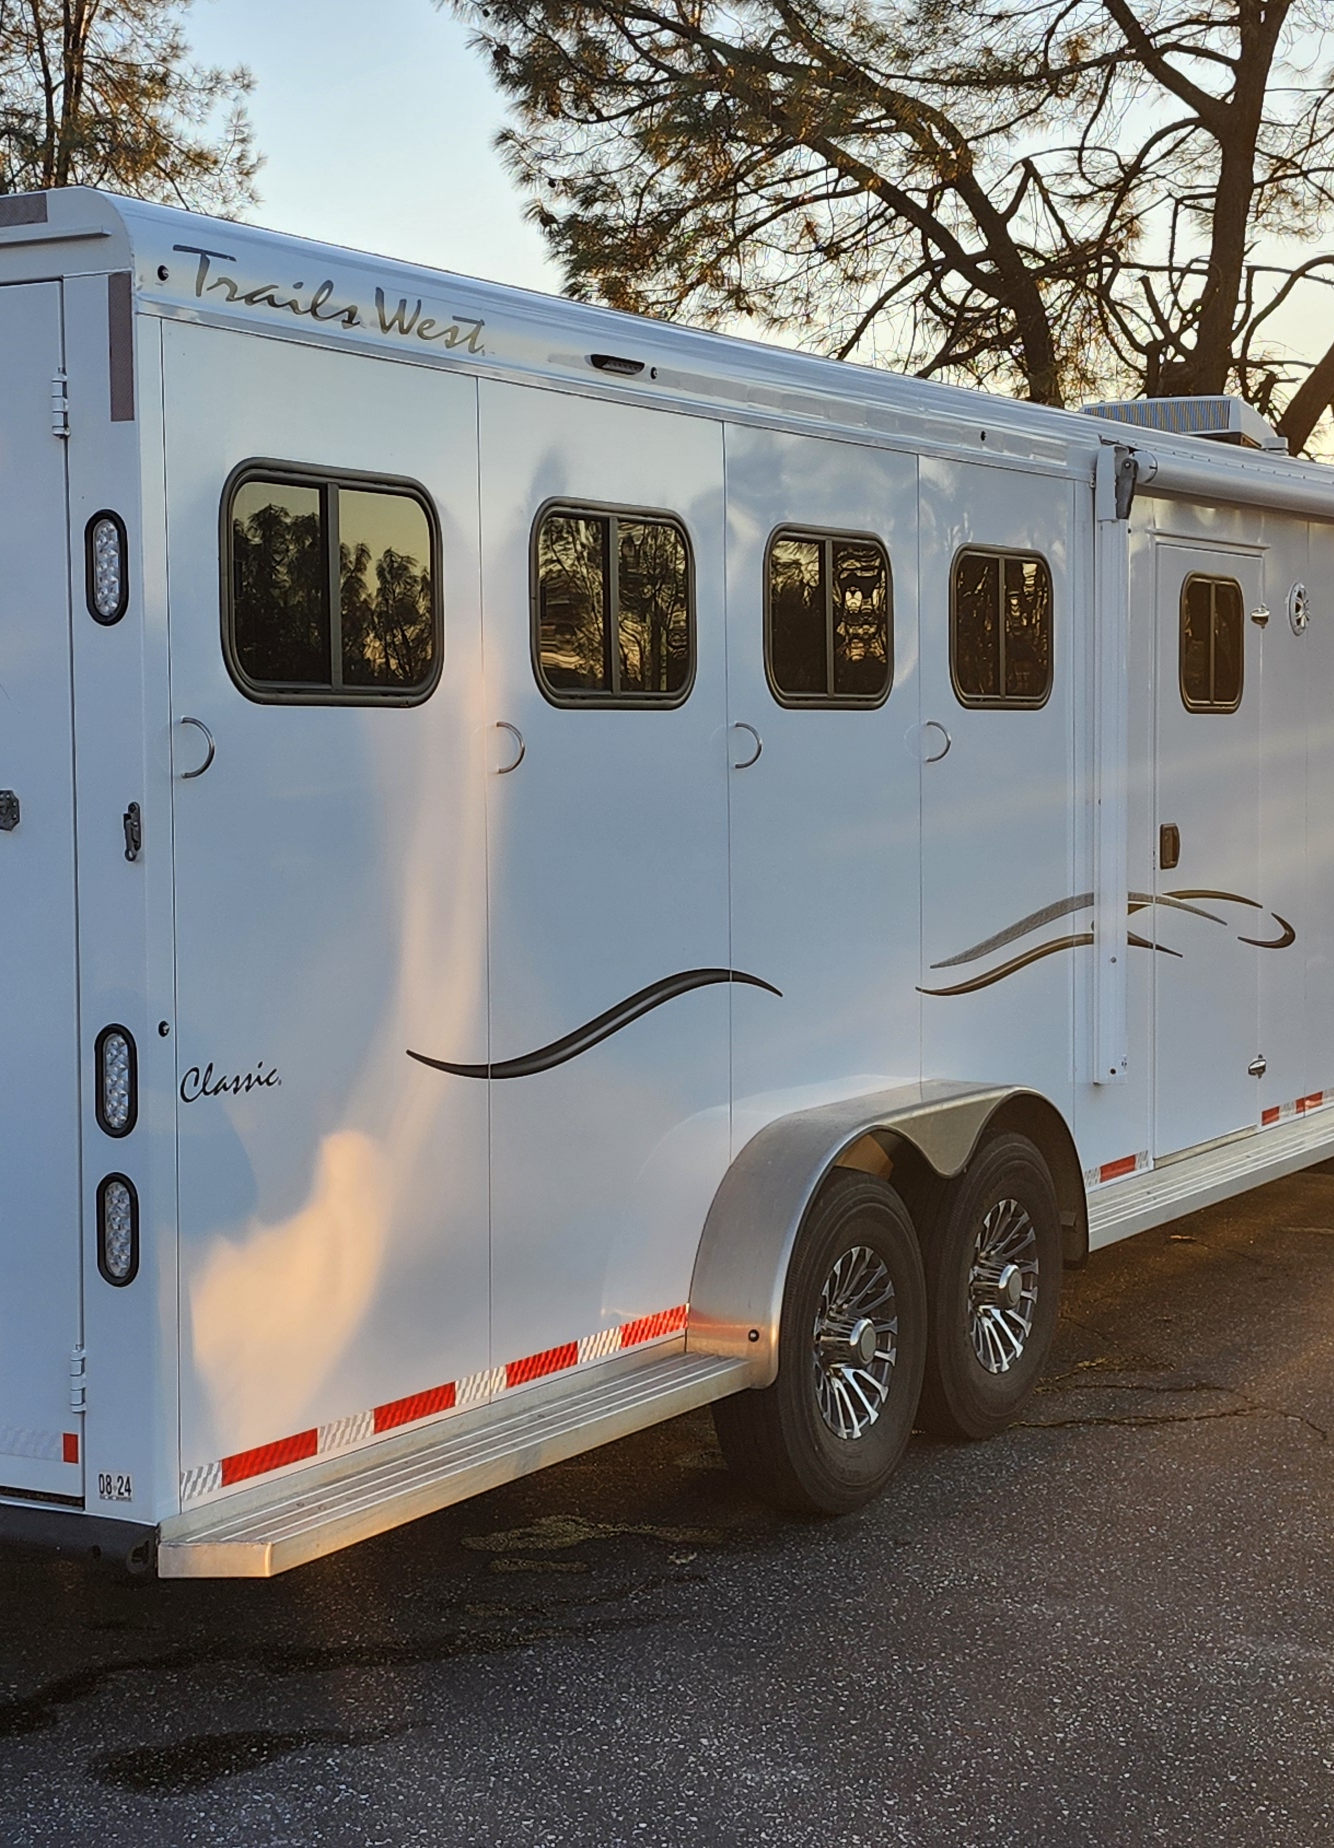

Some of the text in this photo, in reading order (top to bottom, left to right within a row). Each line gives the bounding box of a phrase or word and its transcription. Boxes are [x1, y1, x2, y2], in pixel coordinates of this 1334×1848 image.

[172, 244, 485, 355] Trails West
[179, 1061, 278, 1103] Classic
